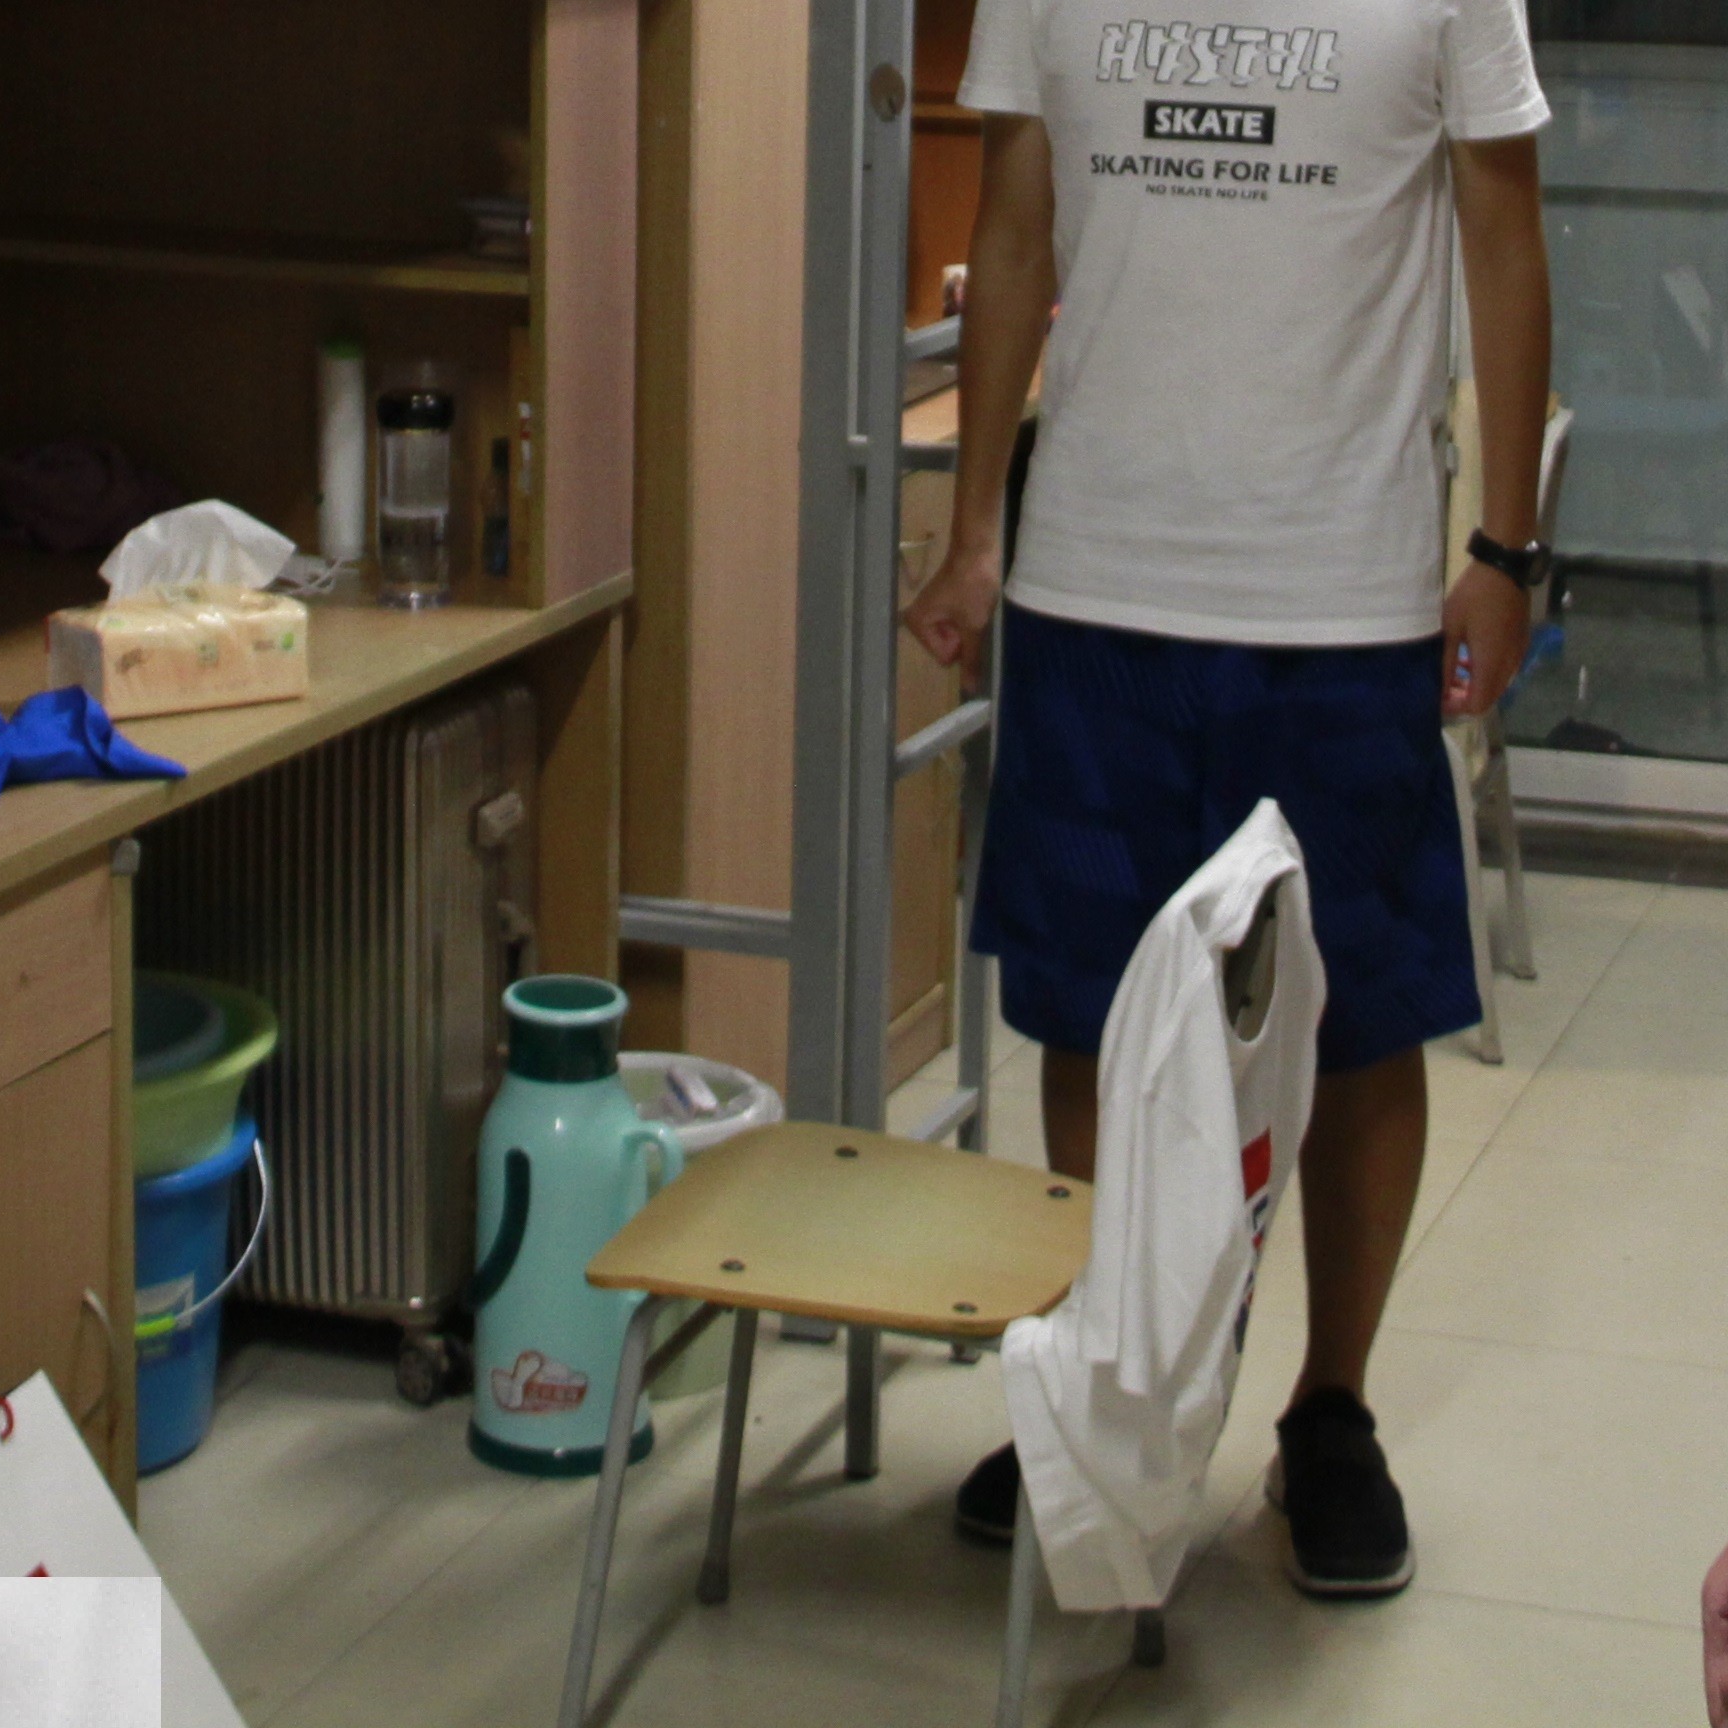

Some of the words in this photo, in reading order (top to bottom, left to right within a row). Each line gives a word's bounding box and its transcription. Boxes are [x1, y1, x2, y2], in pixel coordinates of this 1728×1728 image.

[1153, 106, 1264, 138] SKATE
[1090, 154, 1205, 180] SKATING
[1213, 159, 1270, 183] FOR
[1277, 163, 1339, 186] LIFE
[1145, 183, 1167, 195] NO
[1170, 184, 1212, 199] SKATE
[1215, 187, 1237, 200] NO
[1240, 189, 1268, 202] LIFE
